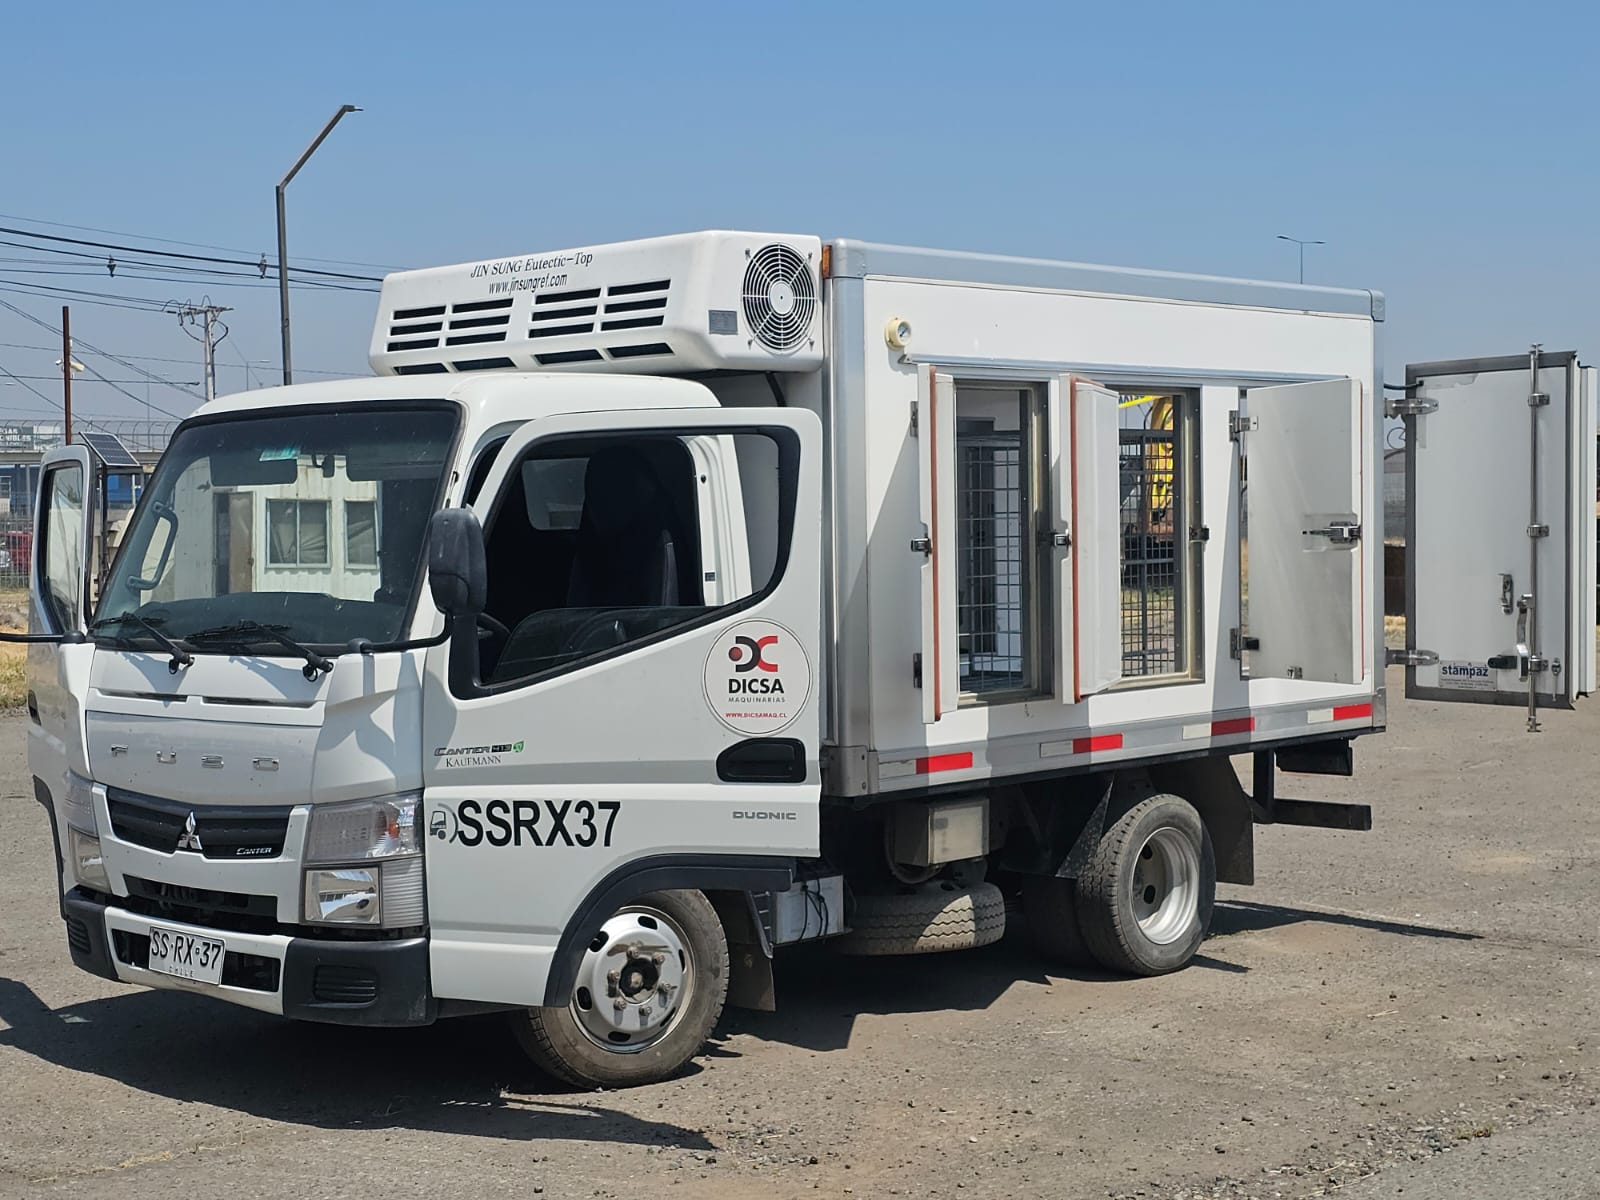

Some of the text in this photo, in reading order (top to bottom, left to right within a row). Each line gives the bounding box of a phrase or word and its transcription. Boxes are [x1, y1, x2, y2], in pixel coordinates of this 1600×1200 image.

[470, 264, 489, 278] JIN
[491, 259, 522, 276] SUNG
[489, 273, 568, 295] www.jinsungref.com
[1441, 664, 1489, 678] stampaz
[728, 678, 785, 694] DICSA
[446, 755, 502, 767] KAUFMANN
[457, 799, 621, 847] SSRX37
[732, 811, 797, 820] DUONIC
